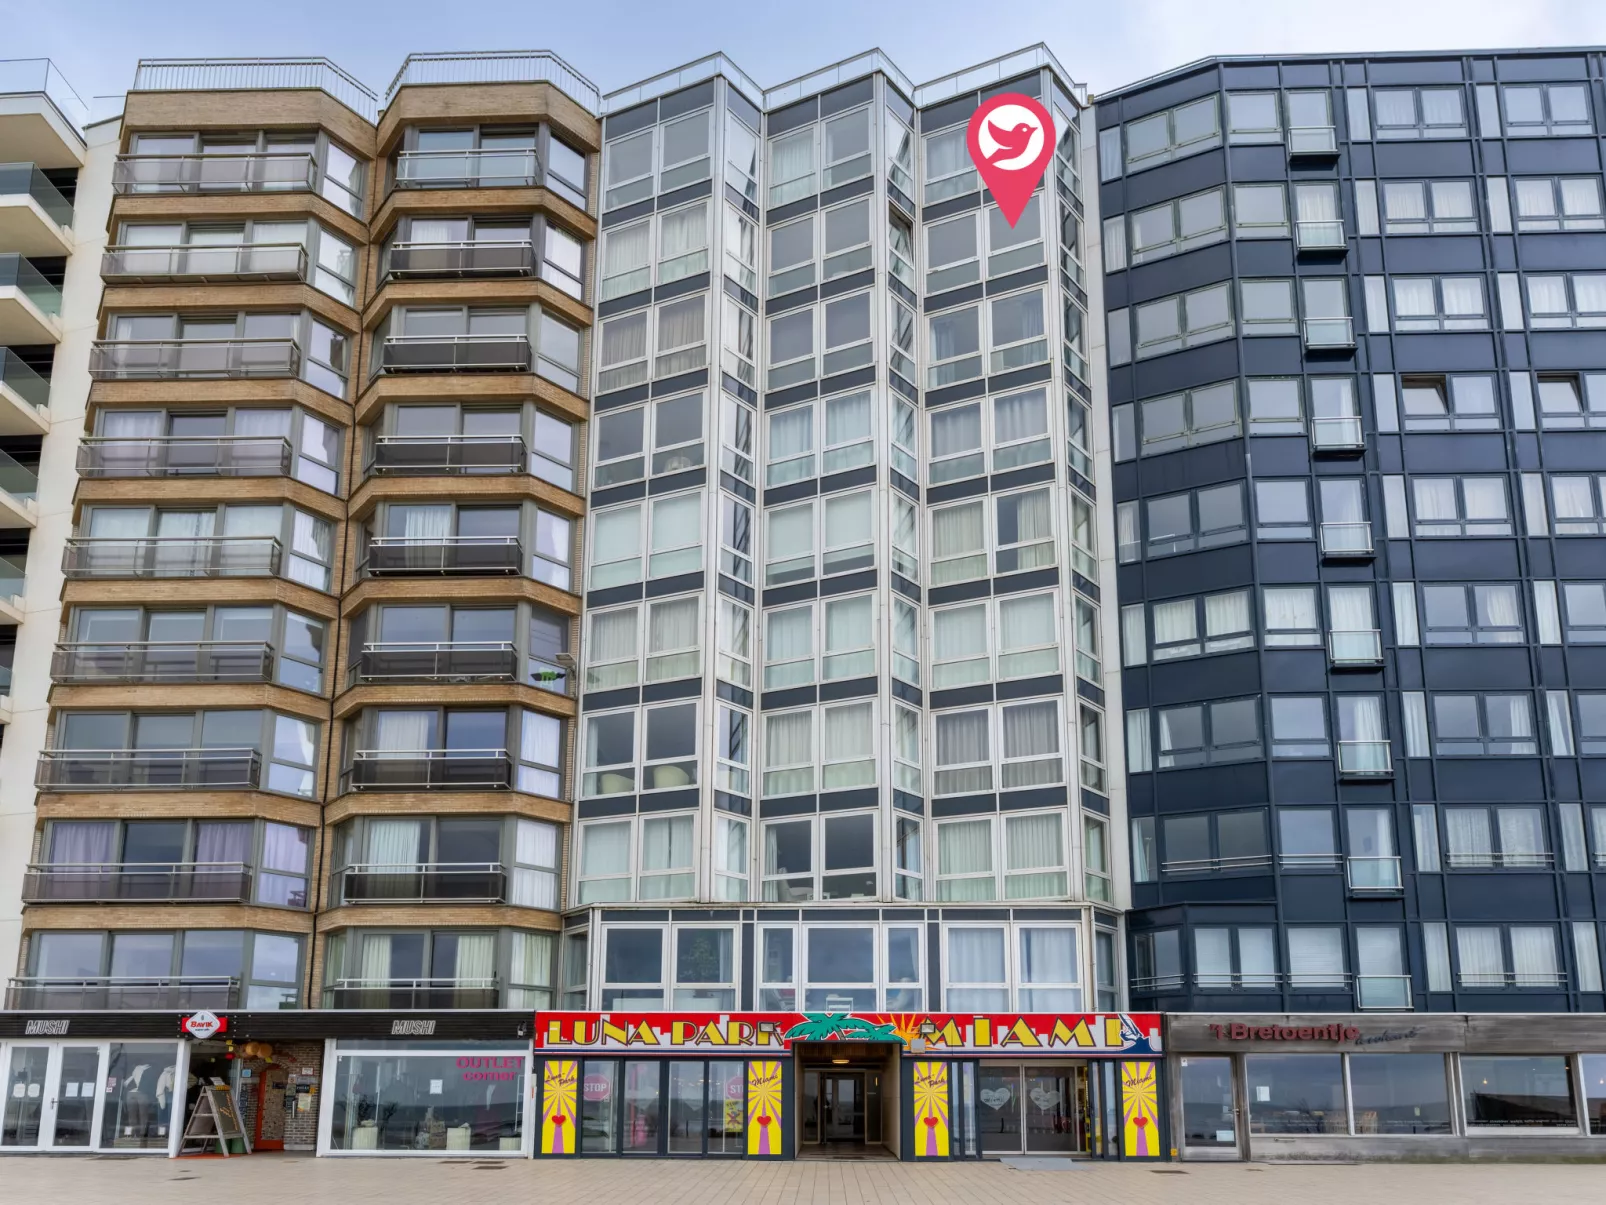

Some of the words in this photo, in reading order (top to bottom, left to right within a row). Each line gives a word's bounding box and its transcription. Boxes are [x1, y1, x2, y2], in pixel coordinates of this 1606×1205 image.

[25, 1019, 70, 1035] MUSHI
[391, 1020, 436, 1035] MUSHI
[548, 1020, 661, 1046] LUNA
[671, 1020, 784, 1047] PARK
[922, 1016, 1122, 1048] MIAMI
[1230, 1023, 1368, 1044] Bretoentje
[456, 1056, 524, 1069] OUTLET
[463, 1071, 517, 1081] corner
[752, 1074, 779, 1087] Miami
[1125, 1074, 1152, 1087] Miami
[584, 1083, 607, 1092] STOP
